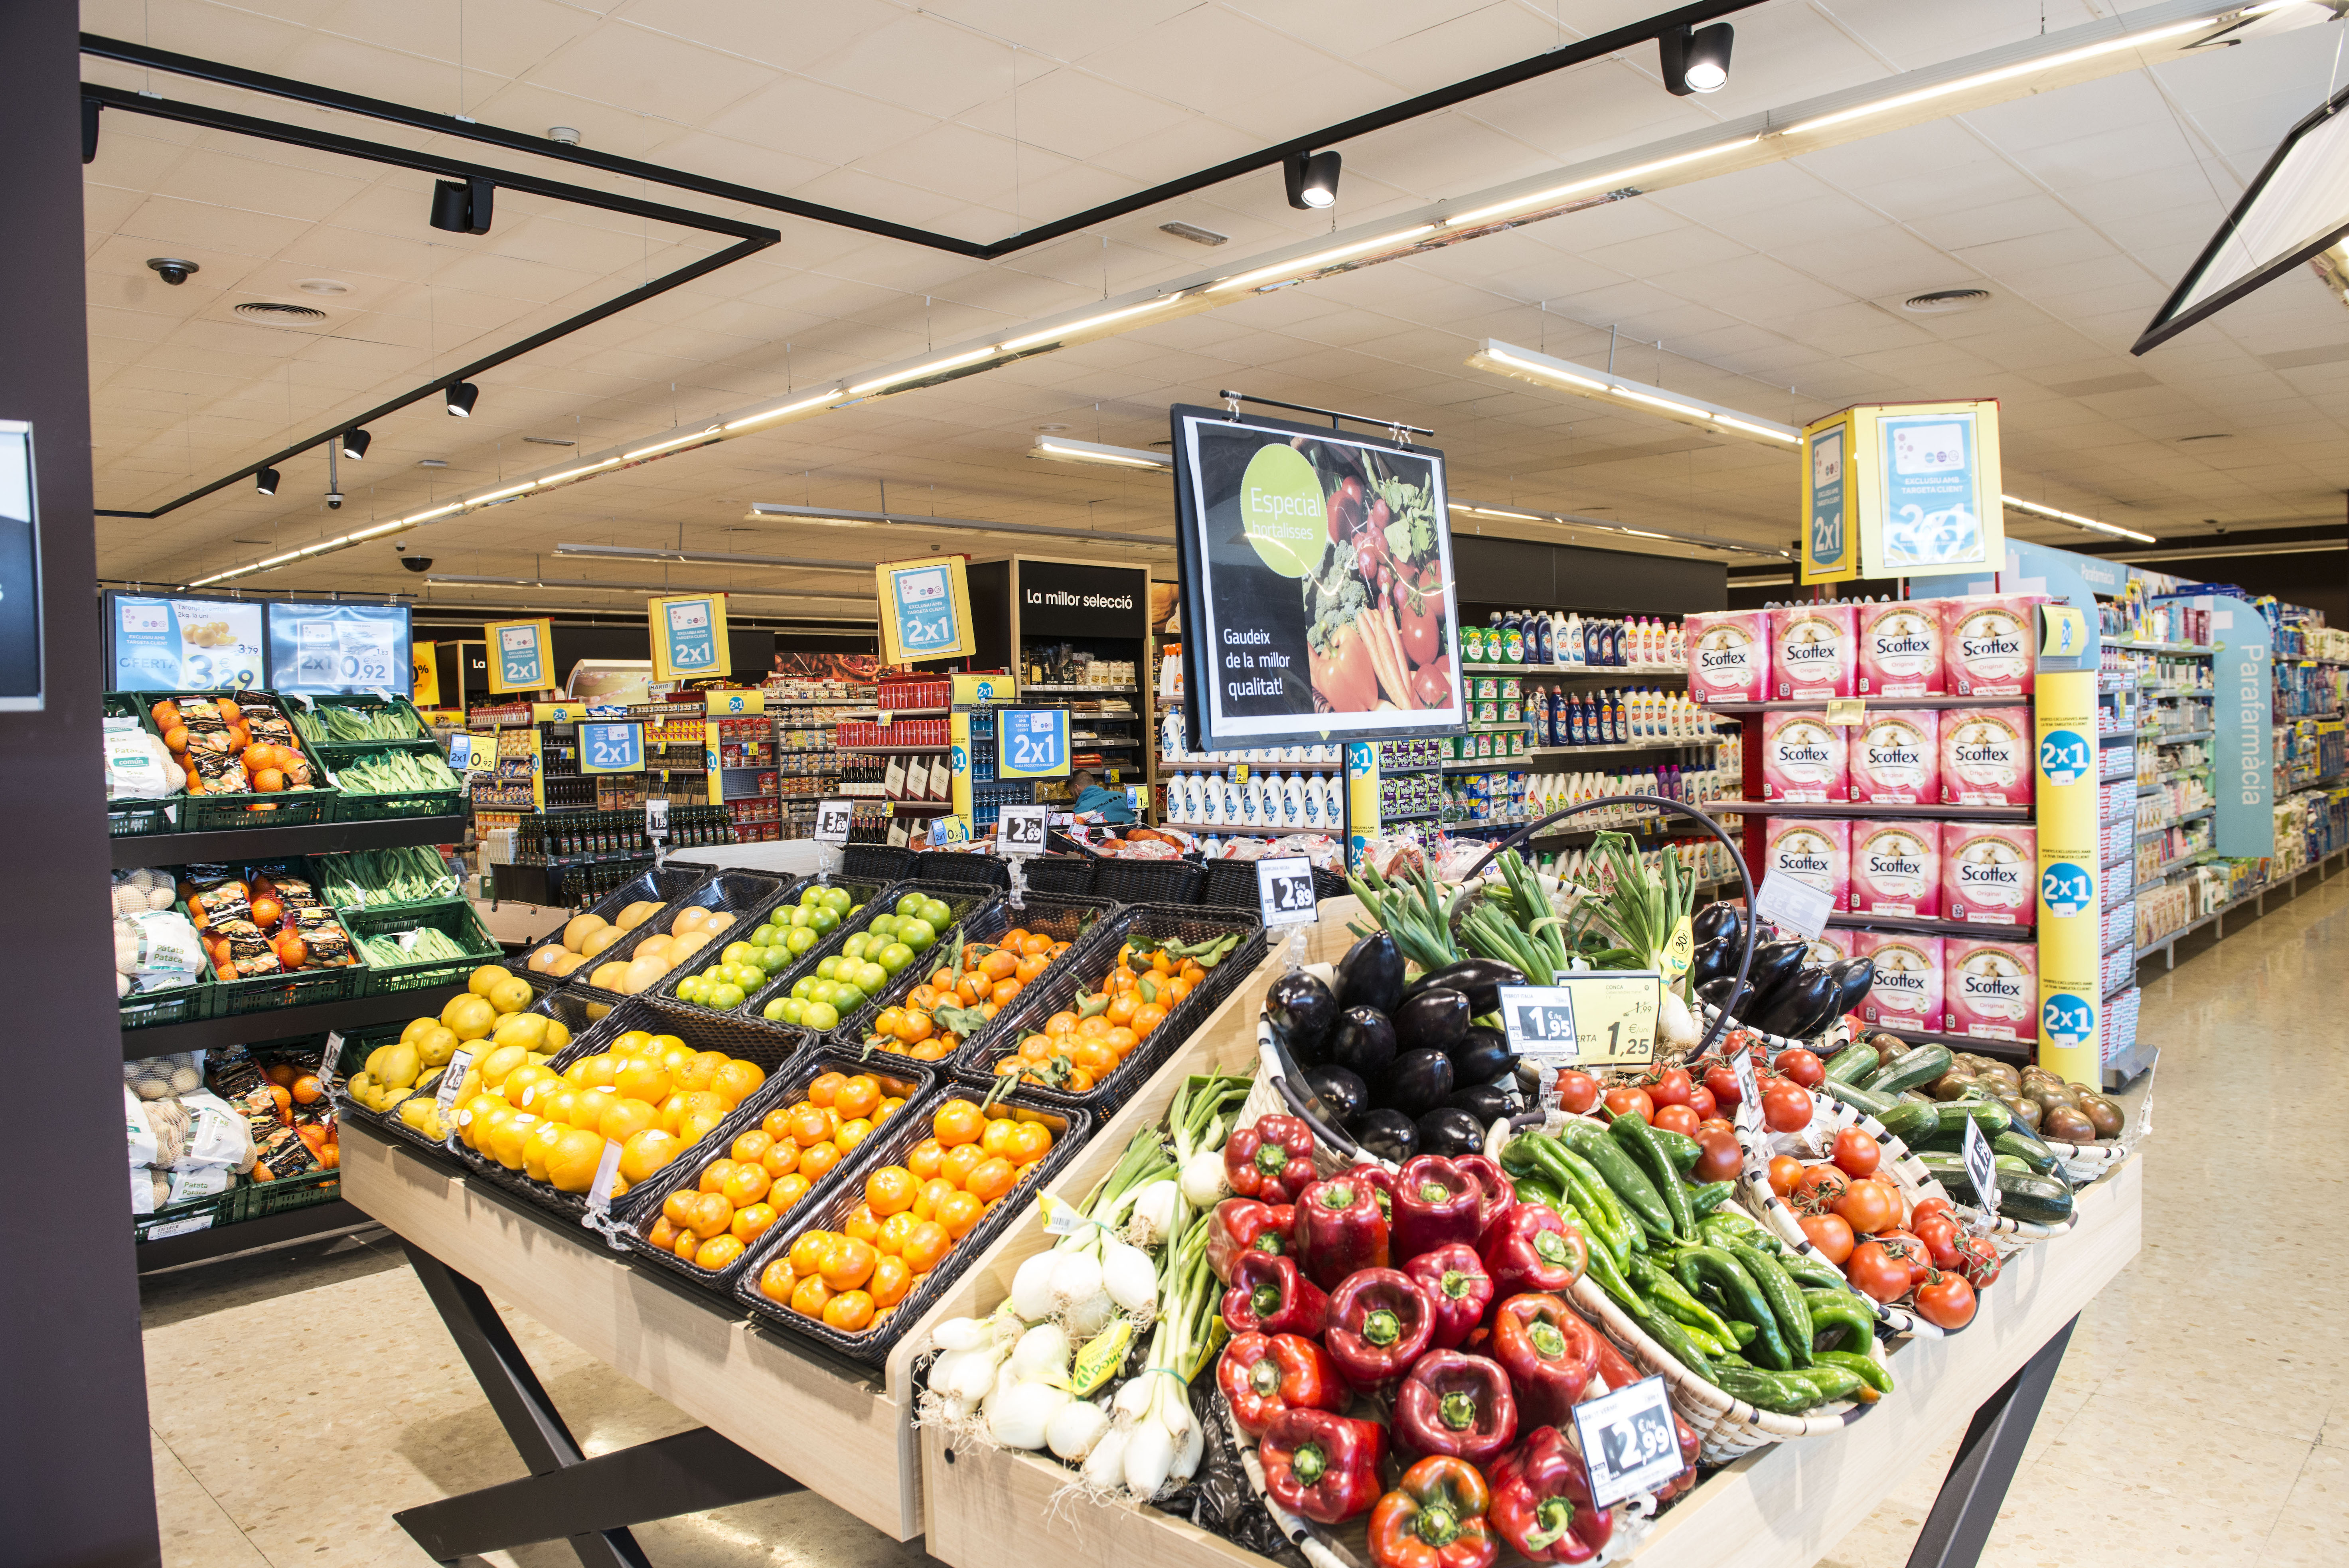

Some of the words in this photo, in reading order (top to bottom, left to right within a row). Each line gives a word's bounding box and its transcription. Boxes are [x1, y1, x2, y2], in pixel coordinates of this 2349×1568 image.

[1251, 487, 1321, 520] Especial
[1252, 520, 1313, 540] hortalisses
[1815, 513, 1840, 552] 2x1
[1027, 589, 1042, 604] La
[1046, 591, 1080, 606] millor
[1083, 594, 1132, 609] selecció
[907, 617, 949, 642] 2x1
[1224, 628, 1270, 644] Gaudeix
[675, 642, 711, 663] 2x1
[1787, 646, 1835, 660] Scottex
[1877, 638, 1930, 654] Scottex
[1963, 640, 2019, 656] Scottex
[119, 658, 178, 669] OFERTA
[302, 656, 332, 669] 2x1
[473, 659, 486, 668] La
[1226, 652, 1240, 668] de
[1243, 652, 1254, 667] la
[1259, 652, 1290, 667] millor
[1702, 651, 1745, 667] Scottex
[507, 661, 537, 679] 2x1
[978, 687, 992, 697] 2x1
[1228, 677, 1283, 701] qualitat!
[730, 700, 744, 709] 2x1
[2240, 644, 2266, 804] Parafarmàcia
[451, 753, 466, 762] 2x1
[593, 741, 630, 763] 2x1
[1014, 734, 1054, 763] 2x1
[1779, 746, 1828, 761] Scottex
[1869, 748, 1919, 764] Scottex
[1955, 746, 2009, 762] Scottex
[2042, 742, 2088, 768] 2x1
[1090, 801, 1108, 811] caprabo
[827, 812, 847, 833] 3,69
[1013, 818, 1041, 843] 2,69
[1779, 855, 1828, 871] Scottex
[1870, 857, 1920, 874] Scottex
[1962, 866, 2017, 883] Scottex
[1279, 878, 1312, 910] 2,89
[2044, 874, 2090, 901] 2x1
[156, 945, 184, 954] Patata
[1676, 933, 1688, 951] 30%
[154, 954, 183, 963] Pataca
[1874, 970, 1924, 989] Scottex
[1965, 977, 2019, 995] Scottex
[1528, 1007, 1571, 1040] 1,95
[2045, 1004, 2091, 1032] 2x1
[1607, 1021, 1649, 1057] 1,25
[1629, 1024, 1650, 1033] €/uni.
[1611, 1420, 1670, 1466] 2,99
